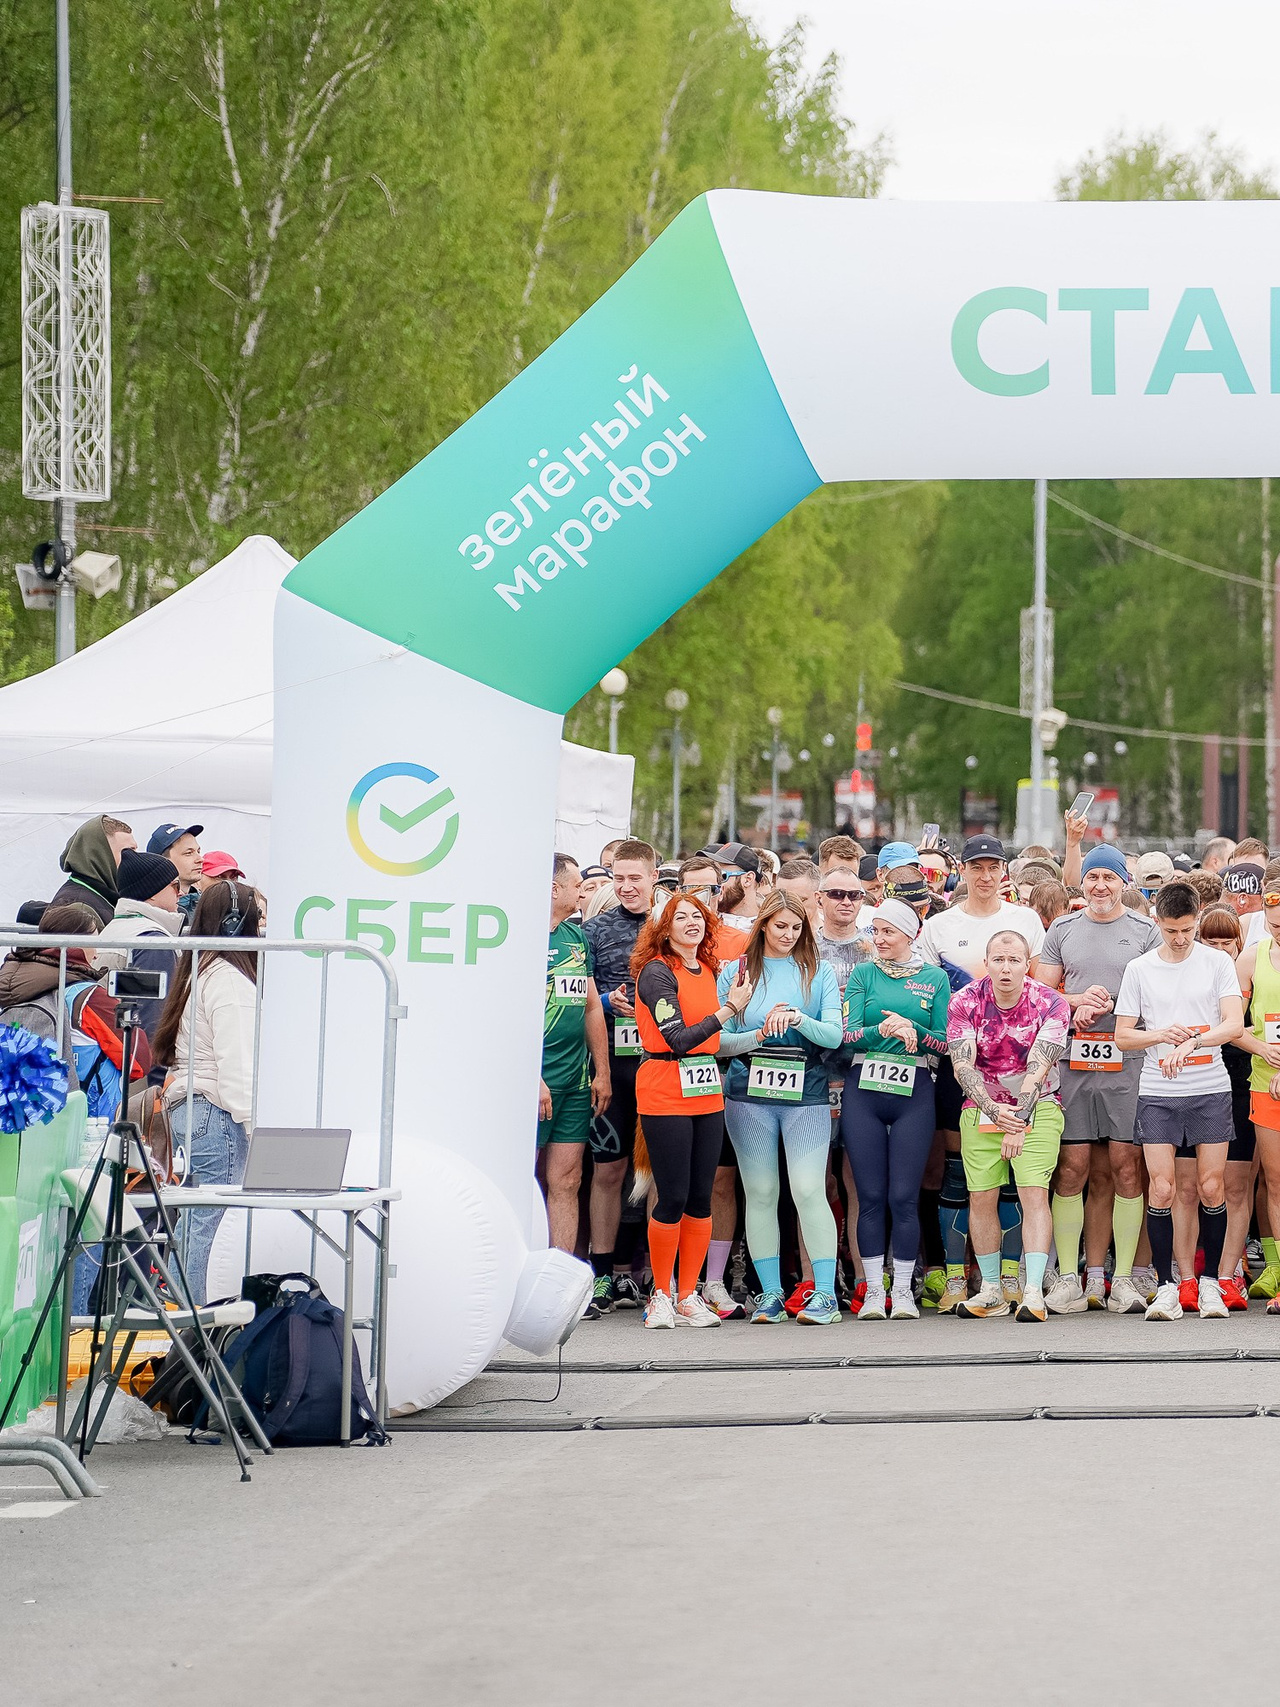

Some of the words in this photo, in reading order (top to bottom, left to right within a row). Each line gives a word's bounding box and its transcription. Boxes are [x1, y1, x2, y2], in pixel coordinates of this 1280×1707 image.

[457, 363, 671, 571] зелёный
[492, 412, 707, 612] марафон
[294, 895, 509, 965] СБЕР
[561, 979, 586, 994] 1400
[904, 979, 935, 993] Sports
[621, 1029, 639, 1044] 11
[1080, 1043, 1113, 1059] 363
[686, 1067, 718, 1085] 1221
[756, 1070, 797, 1088] 1191
[868, 1063, 909, 1082] 1126
